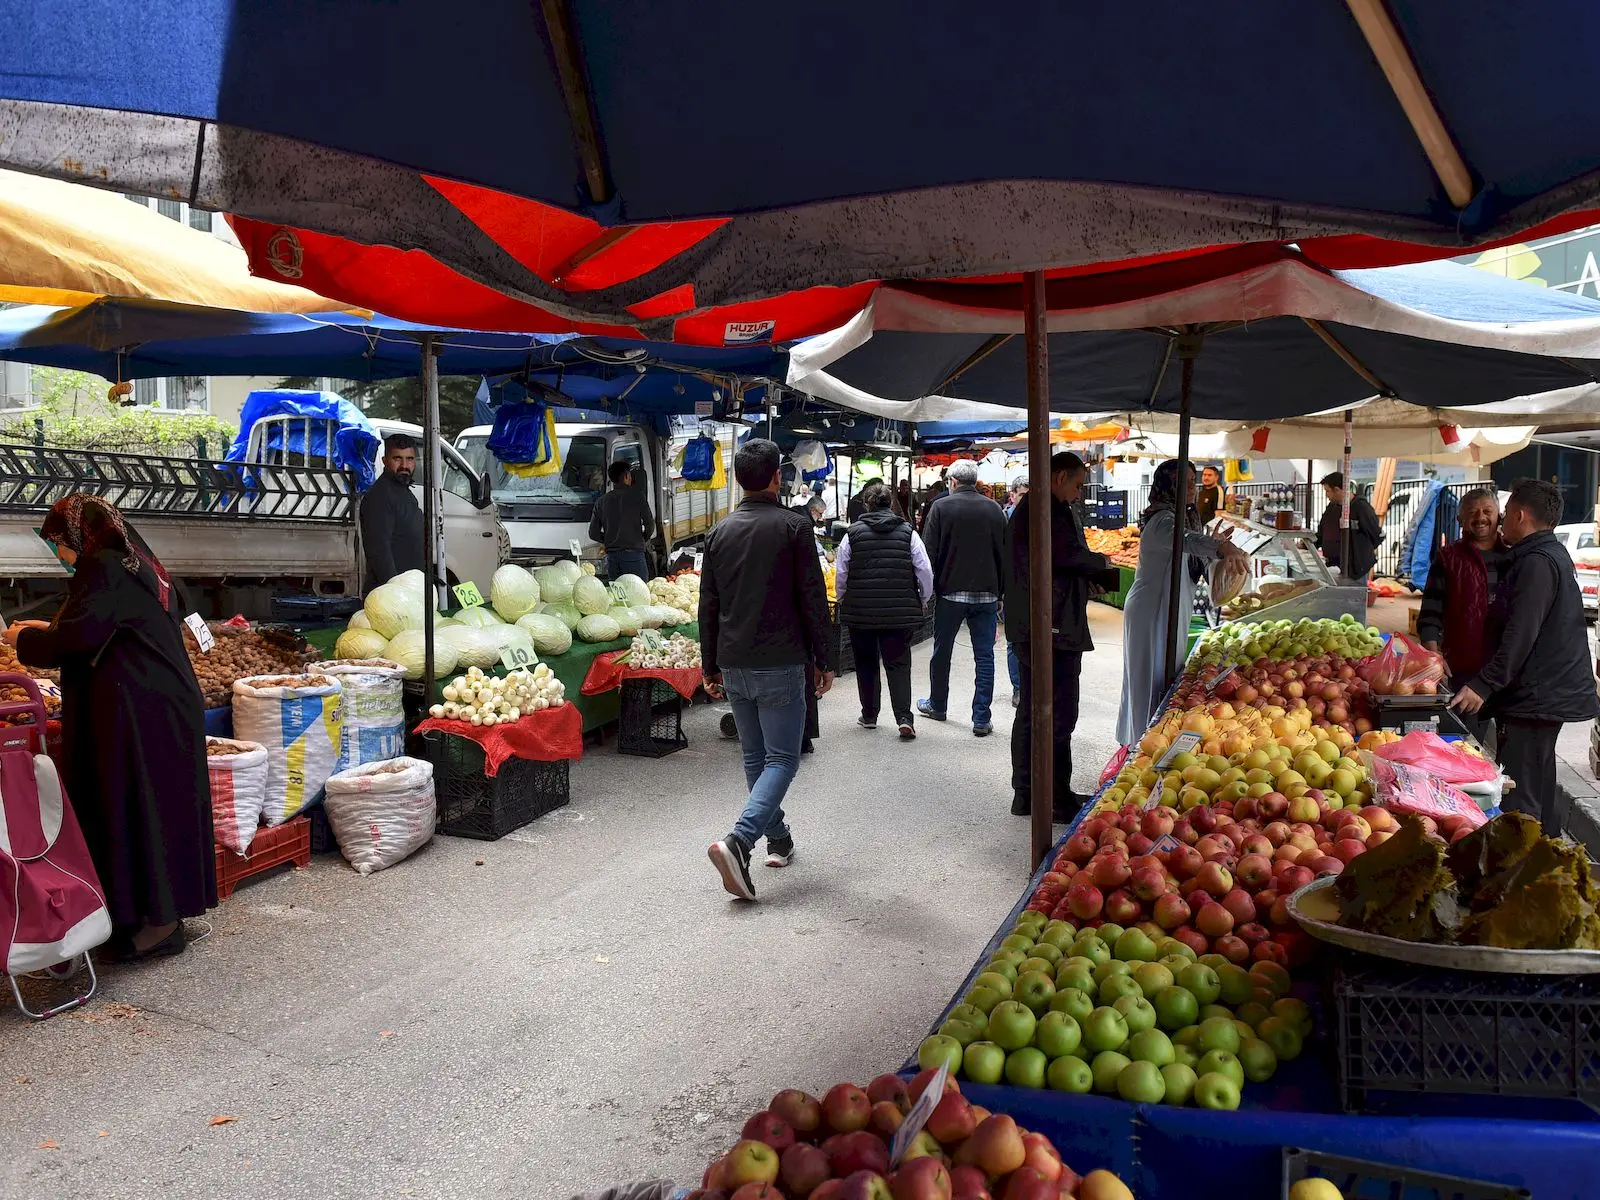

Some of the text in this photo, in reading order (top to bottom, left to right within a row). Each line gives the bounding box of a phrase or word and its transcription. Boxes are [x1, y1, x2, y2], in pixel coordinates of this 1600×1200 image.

[730, 322, 768, 332] HUZUR
[460, 588, 478, 606] 25
[195, 623, 212, 646] 25
[509, 648, 529, 667] 10
[289, 770, 304, 785] 18
